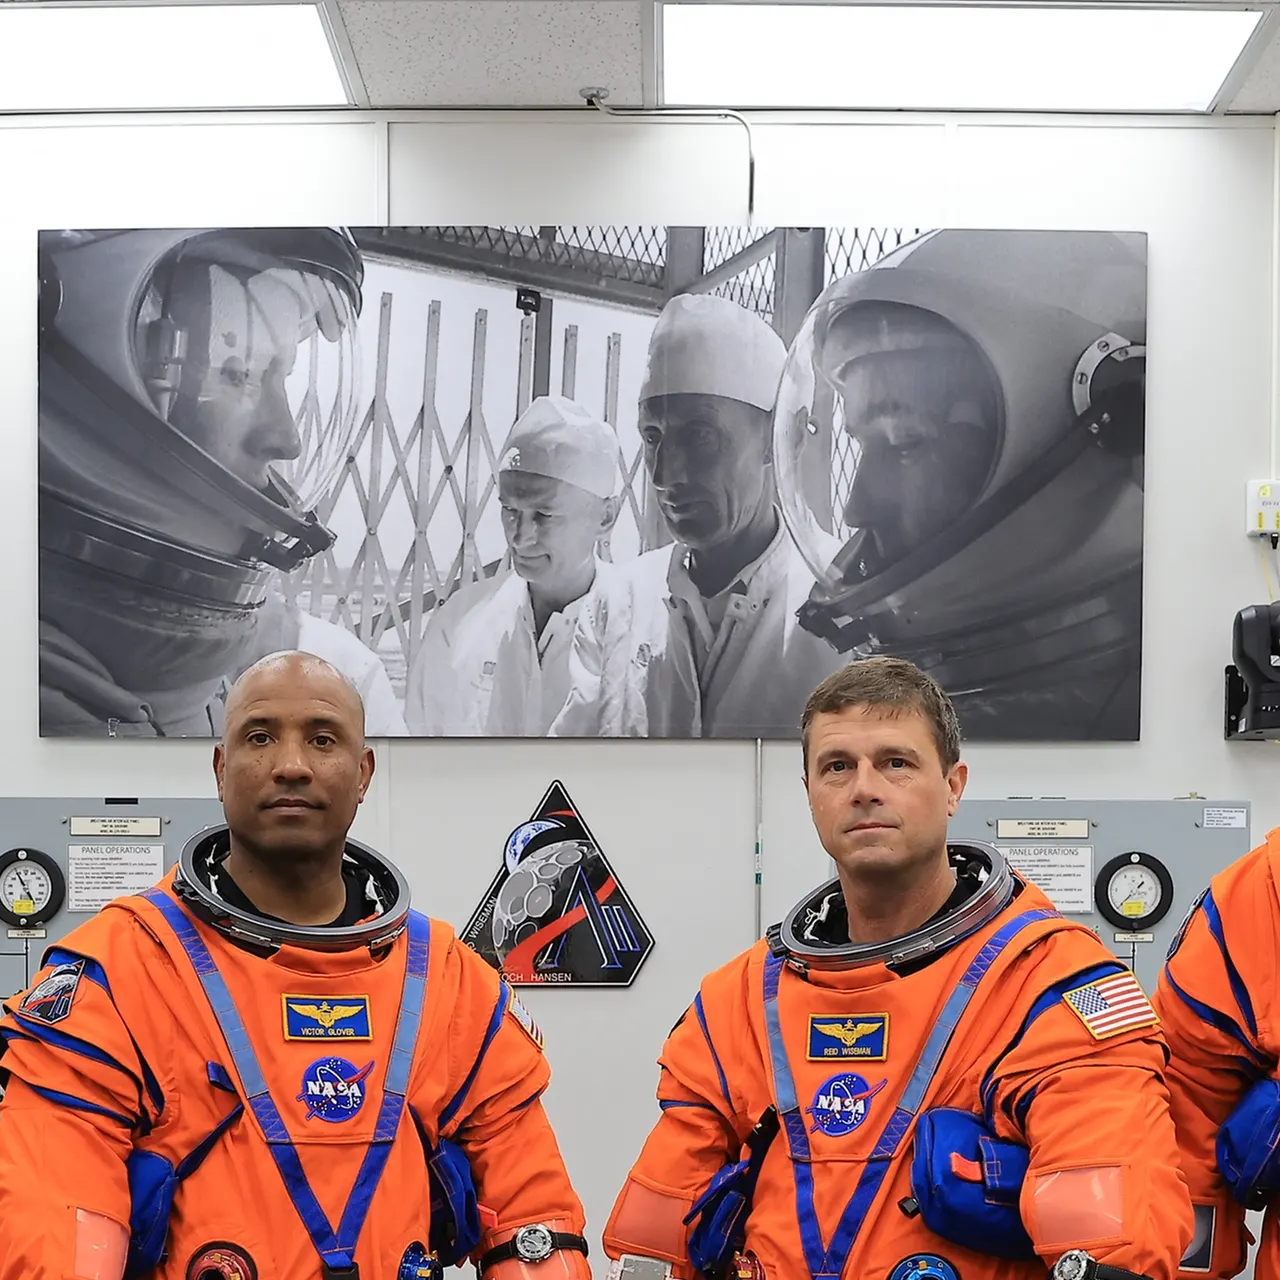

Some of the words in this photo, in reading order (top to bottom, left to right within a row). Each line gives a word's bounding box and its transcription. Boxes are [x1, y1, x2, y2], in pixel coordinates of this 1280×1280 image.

[81, 846, 104, 854] PANEL
[105, 846, 151, 854] OPERATIONS
[1009, 848, 1032, 856] PANEL
[1033, 848, 1079, 856] OPERATIONS
[468, 895, 498, 939] WISEMAN
[530, 972, 572, 982] HANSEN
[301, 1028, 325, 1036] VICTOR
[327, 1028, 355, 1036] GLOVER
[823, 1047, 839, 1056] REID
[841, 1047, 872, 1055] WISEMAN
[307, 1080, 362, 1097] NASA
[816, 1094, 865, 1114] NASA
